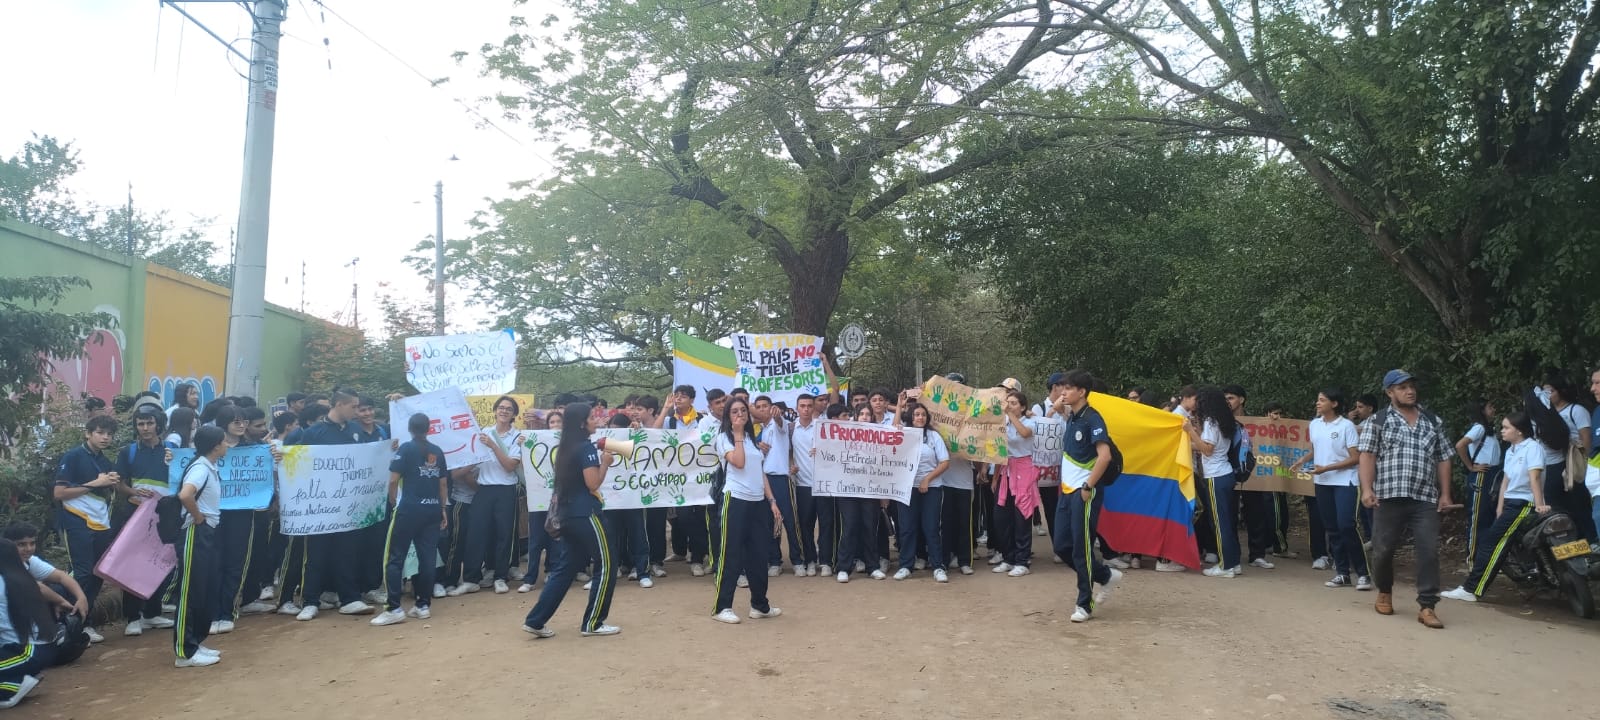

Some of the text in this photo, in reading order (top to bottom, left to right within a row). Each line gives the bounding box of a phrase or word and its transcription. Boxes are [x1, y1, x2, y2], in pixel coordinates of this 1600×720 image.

[737, 335, 750, 350] EL
[738, 350, 756, 364] DEL
[794, 345, 815, 360] NO
[757, 360, 799, 377] TIENE
[742, 368, 825, 392] PROFESORES
[230, 455, 250, 467] QUE
[253, 455, 265, 467] SE
